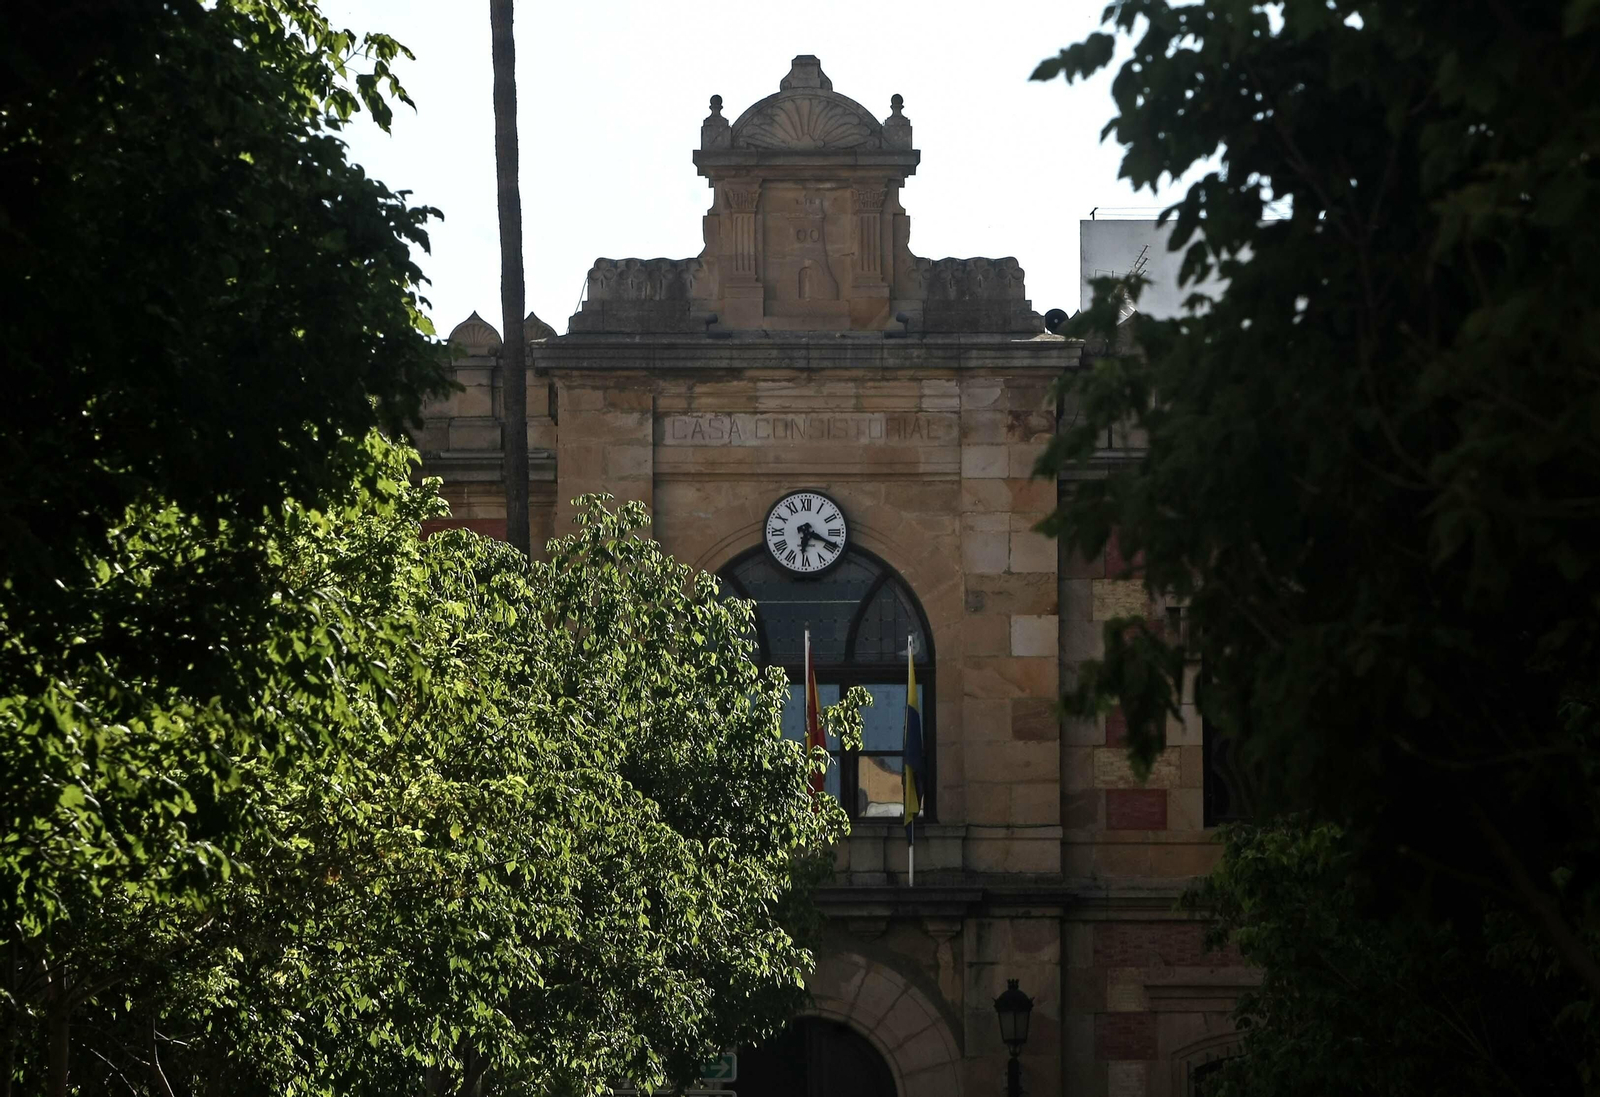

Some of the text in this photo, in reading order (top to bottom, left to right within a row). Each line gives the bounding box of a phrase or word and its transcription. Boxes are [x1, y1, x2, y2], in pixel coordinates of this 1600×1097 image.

[672, 418, 941, 440] CASA CONSISTORIAL
[785, 502, 798, 516] XI
[800, 499, 812, 511] XII
[775, 513, 788, 524] X
[824, 514, 837, 523] II
[772, 527, 784, 536] IX
[817, 552, 826, 564] V
